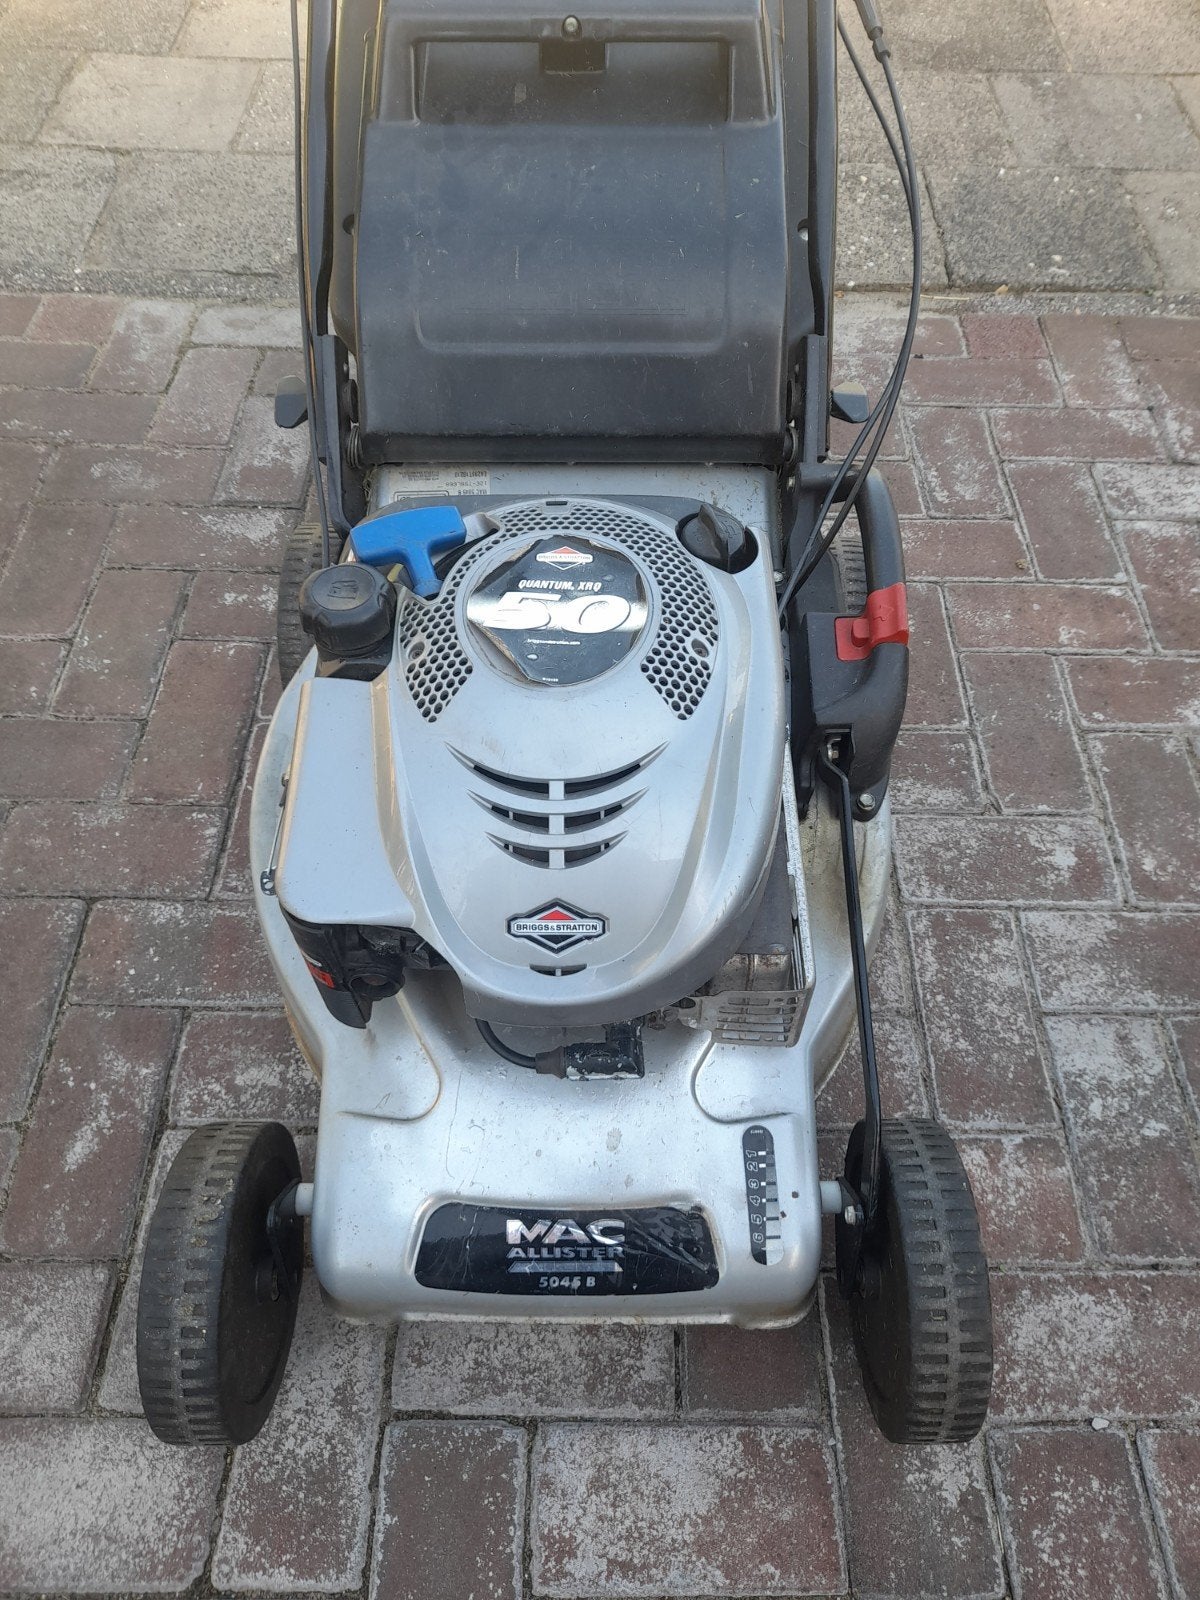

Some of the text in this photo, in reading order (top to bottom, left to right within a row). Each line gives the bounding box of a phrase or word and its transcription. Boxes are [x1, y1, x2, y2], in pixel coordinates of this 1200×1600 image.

[518, 579, 602, 592] QUANTUM XRQ
[506, 1219, 625, 1245] MAC
[507, 1247, 624, 1258] ALLISTER
[586, 1276, 596, 1287] B
